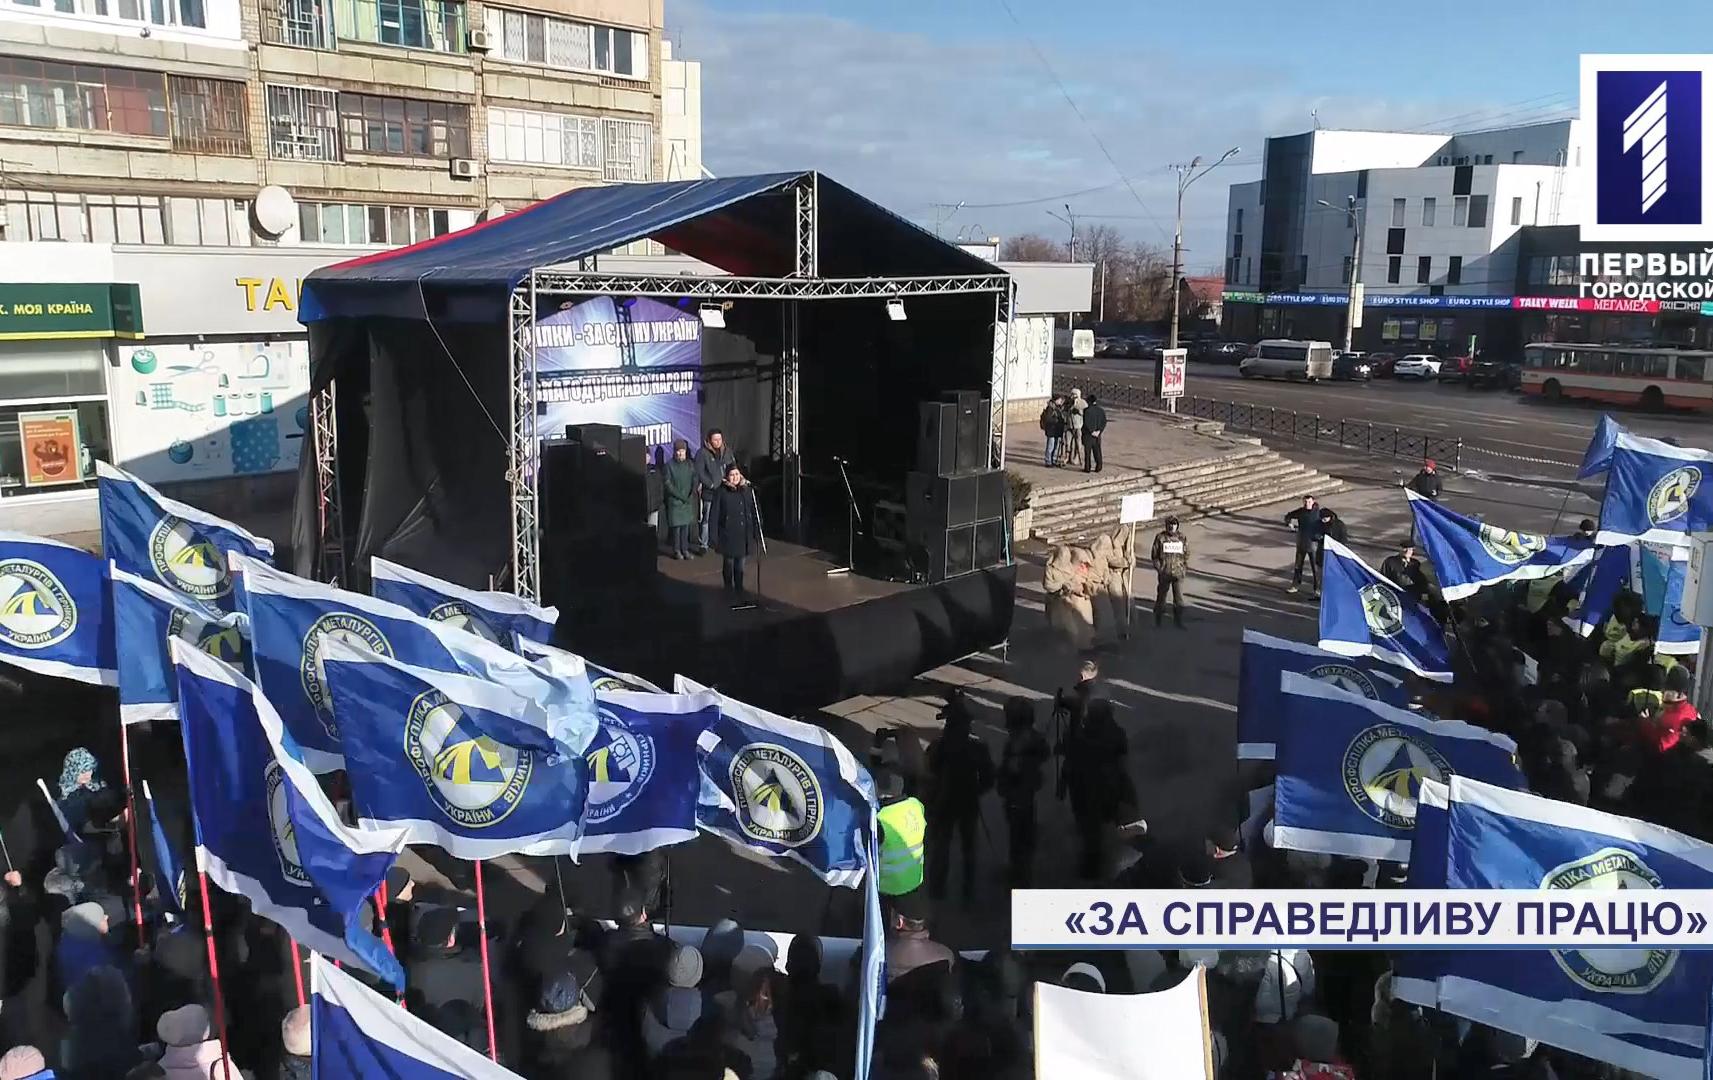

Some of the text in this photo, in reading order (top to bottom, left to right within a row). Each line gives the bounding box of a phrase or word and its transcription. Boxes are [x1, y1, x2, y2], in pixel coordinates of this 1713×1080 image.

[235, 277, 302, 311] ТА
[1372, 296, 1440, 305] EURO STYLE SHOP
[1448, 296, 1510, 306] EURO STYLE SHOP
[1519, 298, 1549, 308] TALLY
[13, 304, 42, 315] МОЯ
[47, 300, 94, 314] КРАЇНА
[583, 322, 604, 346] ЗА
[650, 371, 694, 395] НАРОДУ
[177, 579, 218, 596] УКРАЇНИ
[8, 630, 52, 644] УКРАЇНИ
[322, 618, 386, 655] МЕТАЛУРГІВ
[409, 699, 433, 788] ПРОФСПІЛКА
[752, 749, 812, 790] МЕТАЛУРГІВ
[444, 801, 495, 824] УКРАЇНИ
[748, 821, 791, 839] УКРАЇНИ
